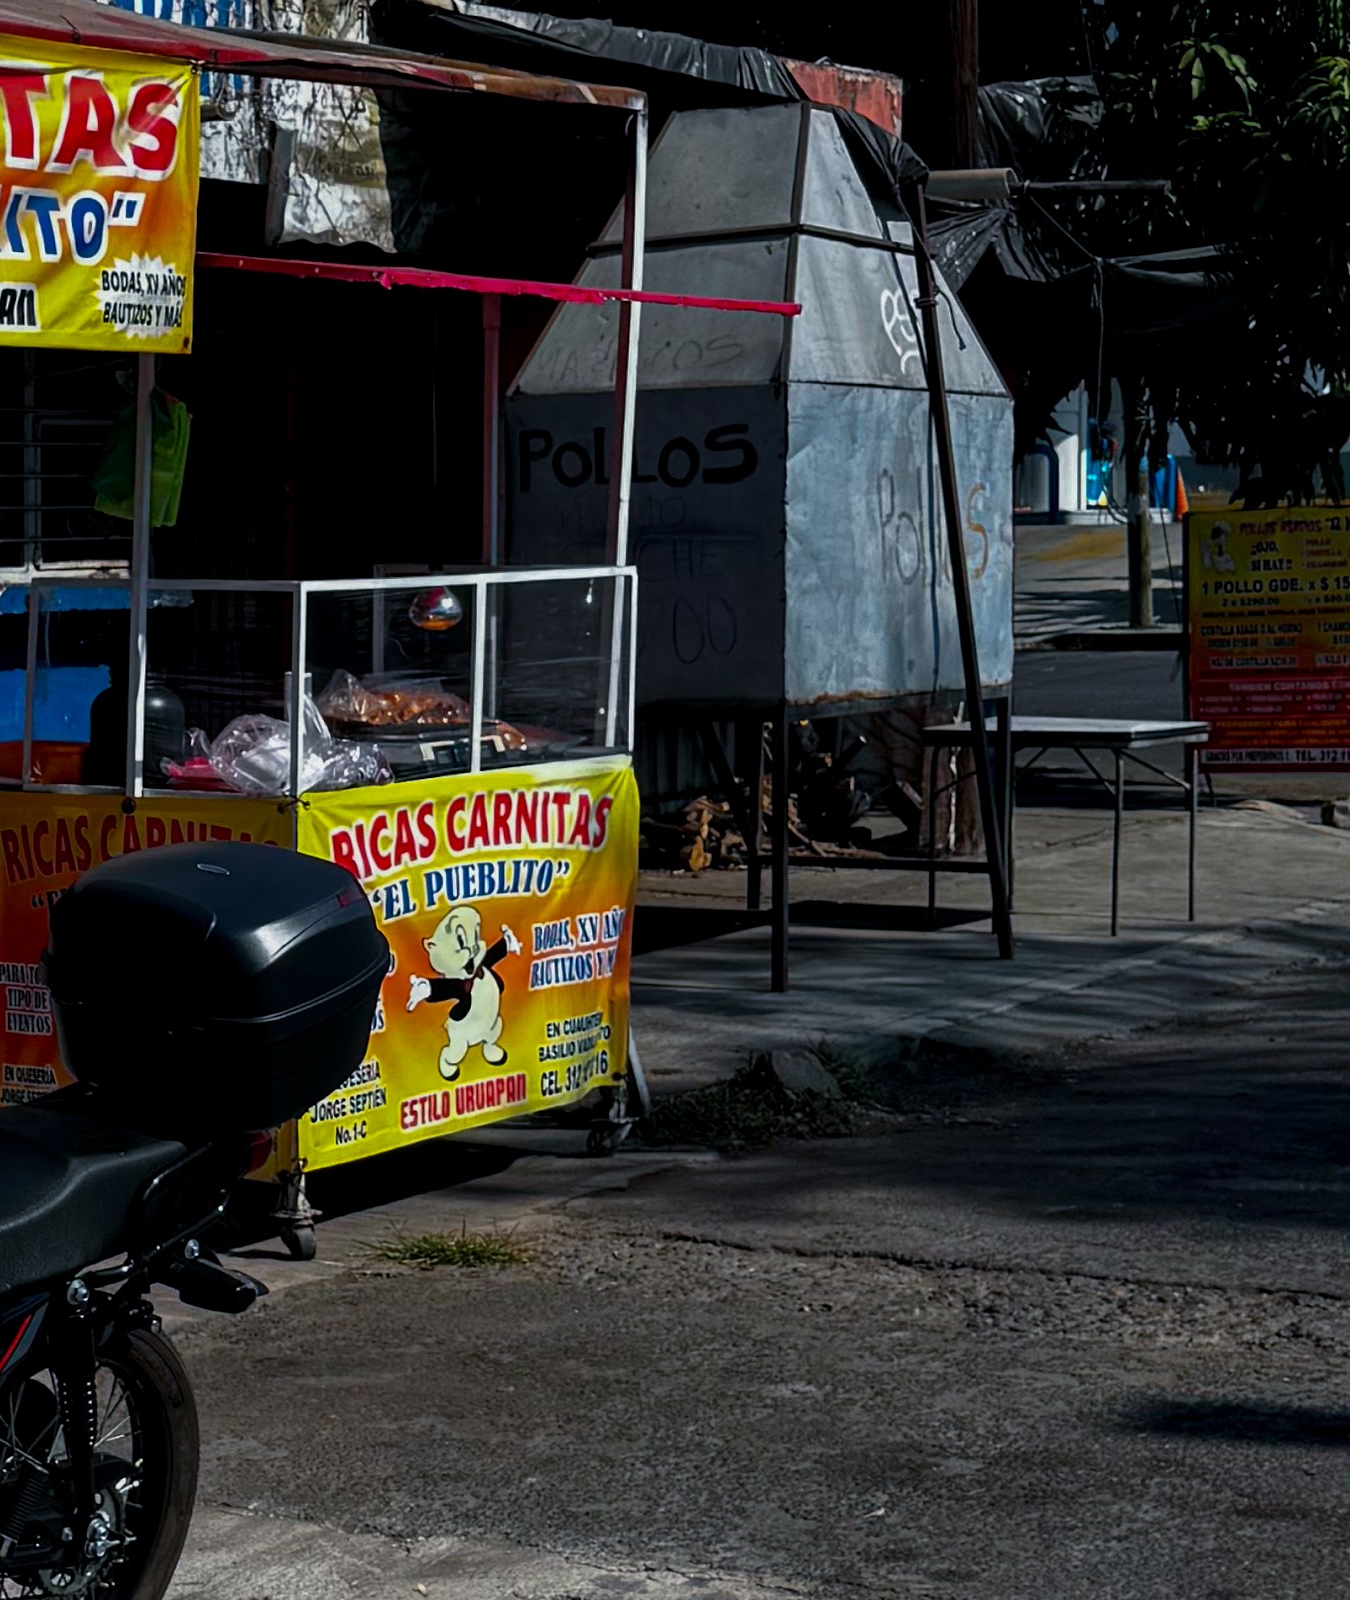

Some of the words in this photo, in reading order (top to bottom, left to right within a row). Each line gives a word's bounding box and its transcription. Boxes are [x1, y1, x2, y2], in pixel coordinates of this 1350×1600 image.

[103, 302, 153, 326] BAUTIZOS
[156, 304, 163, 327] Y
[1214, 580, 1263, 595] POLLO
[331, 802, 436, 879] RICAS
[446, 791, 612, 852] CARNITAS
[1, 815, 92, 884] RICAS
[578, 914, 598, 943] XV
[530, 952, 593, 989] BAUTIZOS
[9, 988, 32, 1008] TIPO
[35, 990, 47, 1010] DE
[7, 1012, 51, 1033] EVENTOS
[310, 1098, 346, 1123] JORGE
[401, 1091, 450, 1130] ESTILO
[455, 1073, 527, 1116] URUAPAN
